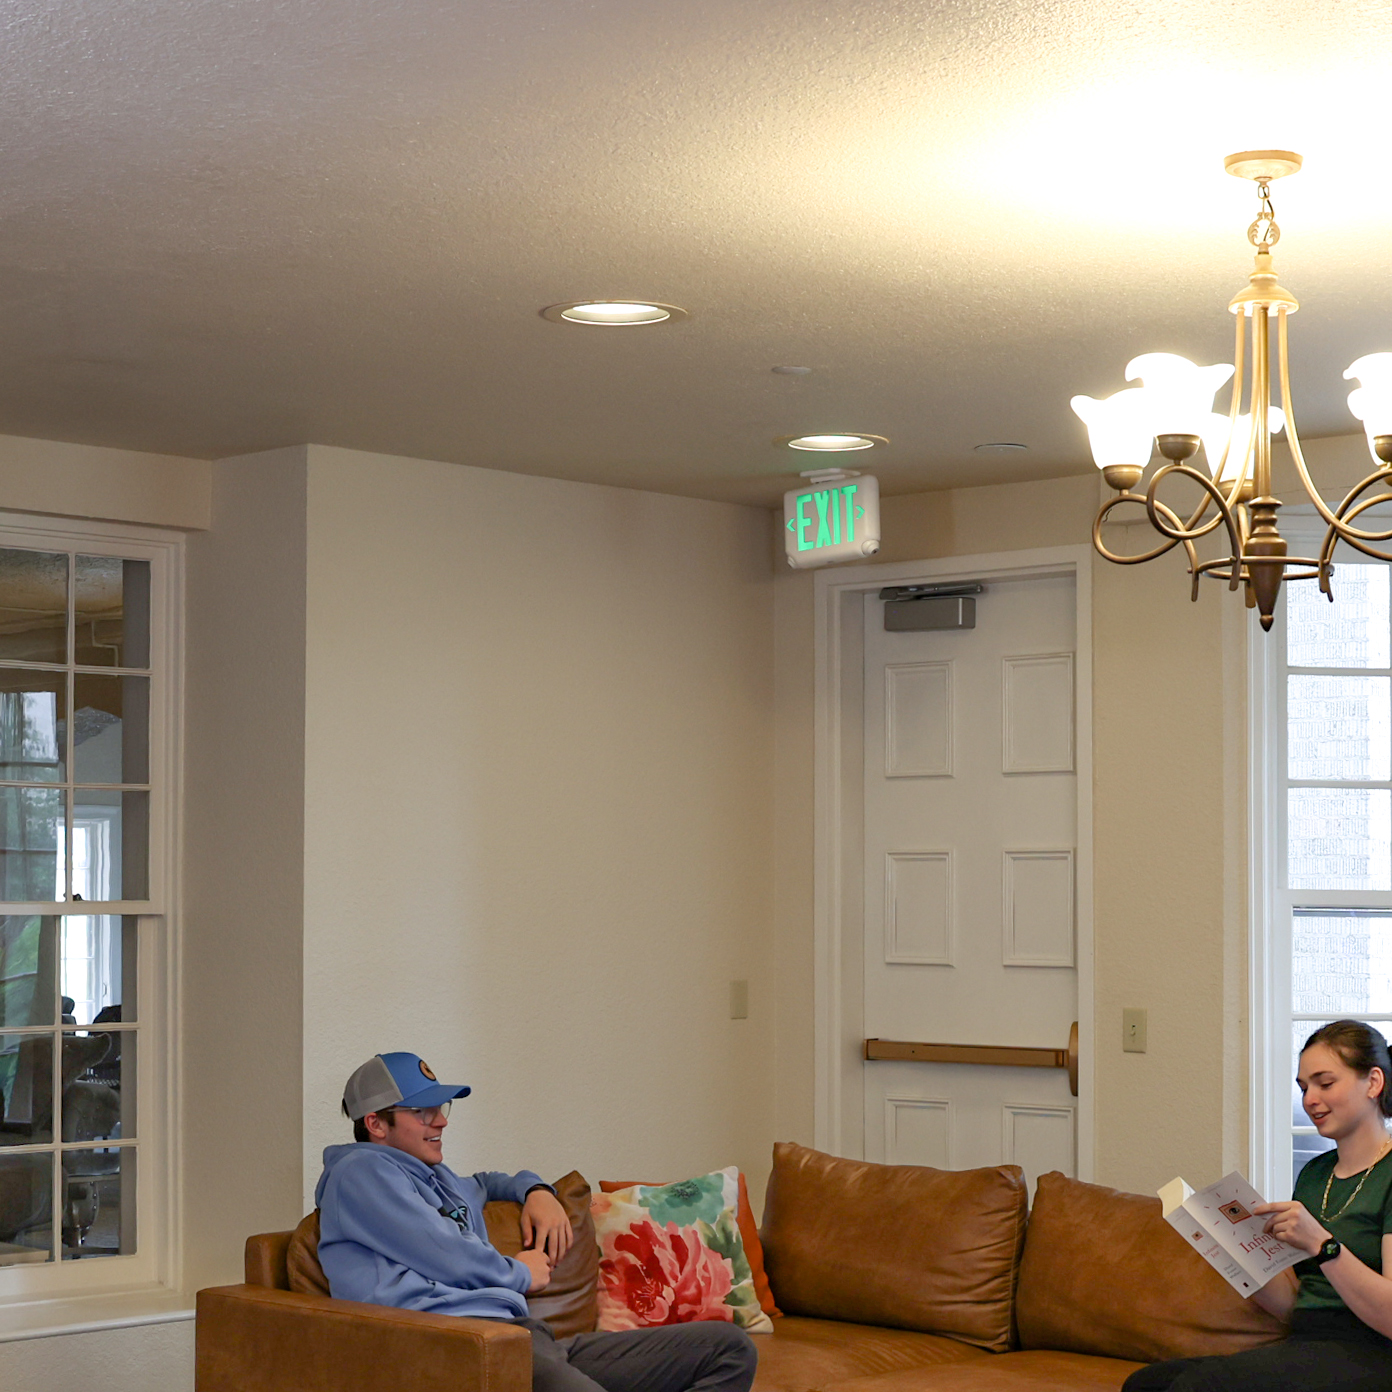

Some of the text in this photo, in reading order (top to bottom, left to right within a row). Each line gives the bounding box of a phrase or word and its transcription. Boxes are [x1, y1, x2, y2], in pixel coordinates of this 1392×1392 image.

[797, 485, 857, 551] EXIT
[1238, 1233, 1274, 1254] Infini
[1259, 1242, 1285, 1261] Jest
